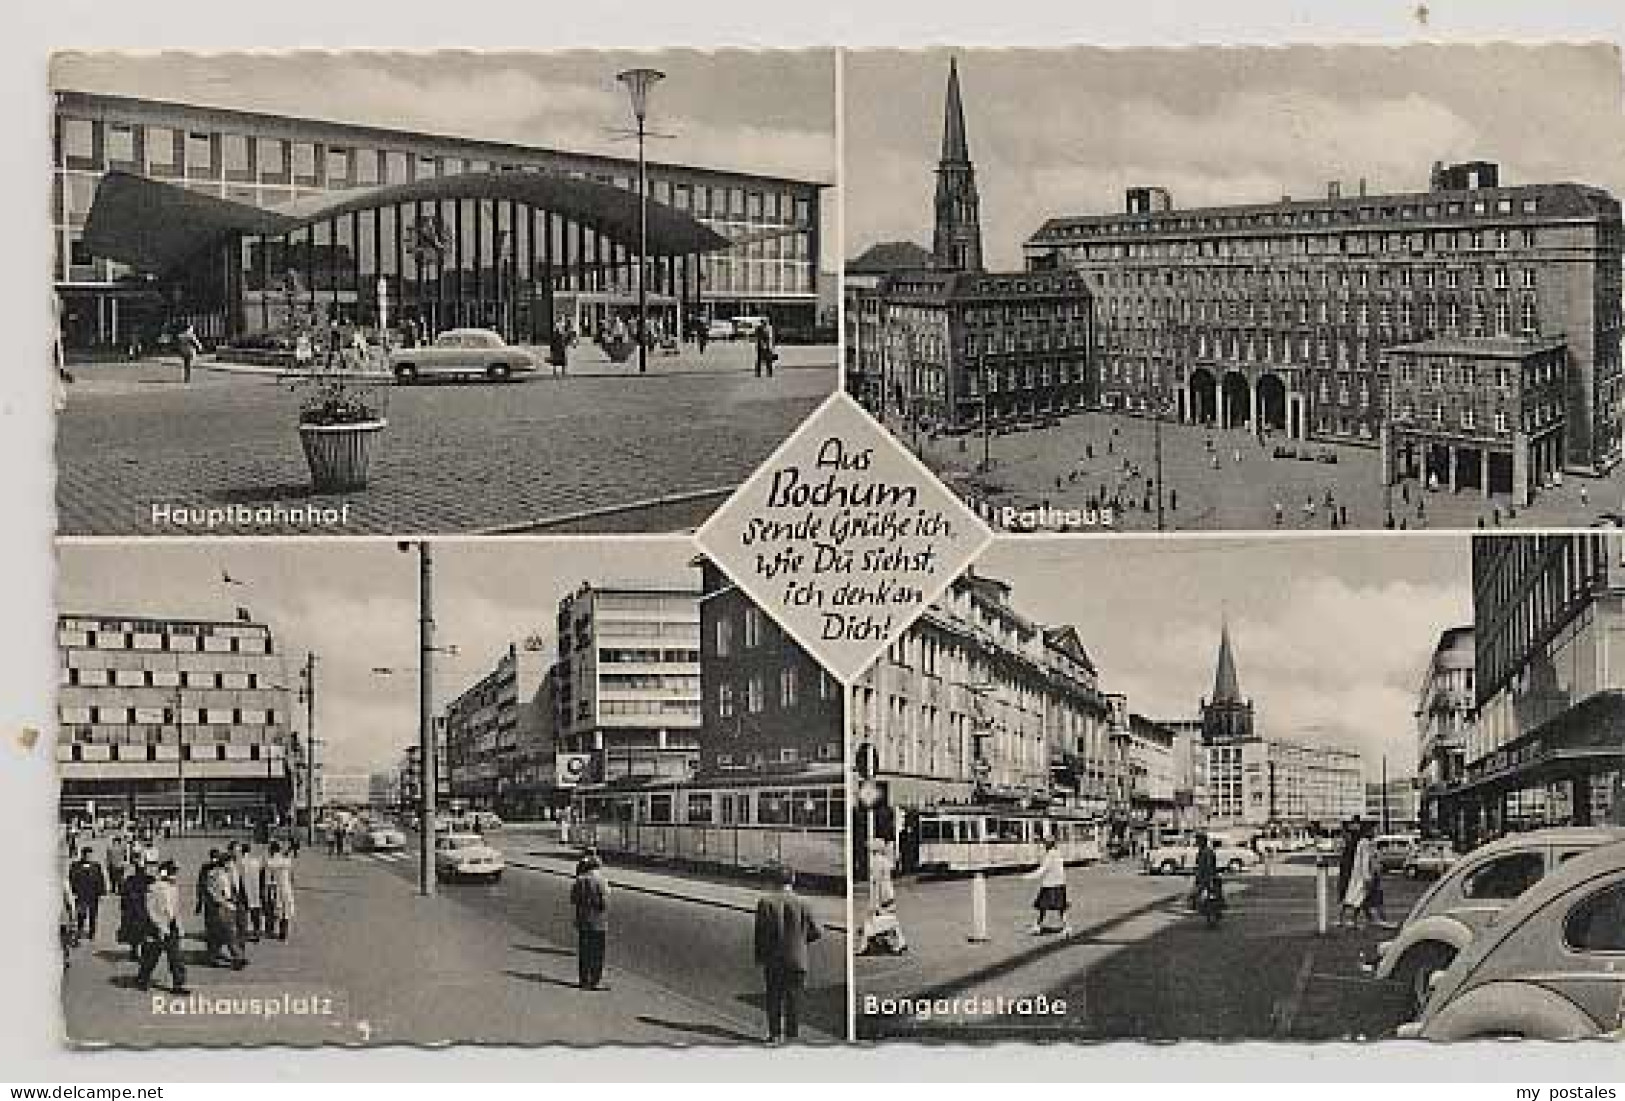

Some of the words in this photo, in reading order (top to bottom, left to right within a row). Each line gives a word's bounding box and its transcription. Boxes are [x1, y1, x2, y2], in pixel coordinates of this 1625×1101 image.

[816, 438, 873, 470] Aus
[768, 467, 917, 507] Bochum
[152, 503, 350, 527] Hauptbahnhof
[743, 512, 822, 544] sende
[830, 510, 911, 544] Grüße
[1002, 506, 1113, 527] Rathaus
[757, 547, 804, 579] wie
[783, 581, 821, 607] ich
[821, 613, 892, 640] Dich!
[152, 993, 333, 1020] Rathausplatz
[863, 995, 1067, 1020] Bongardstraße
